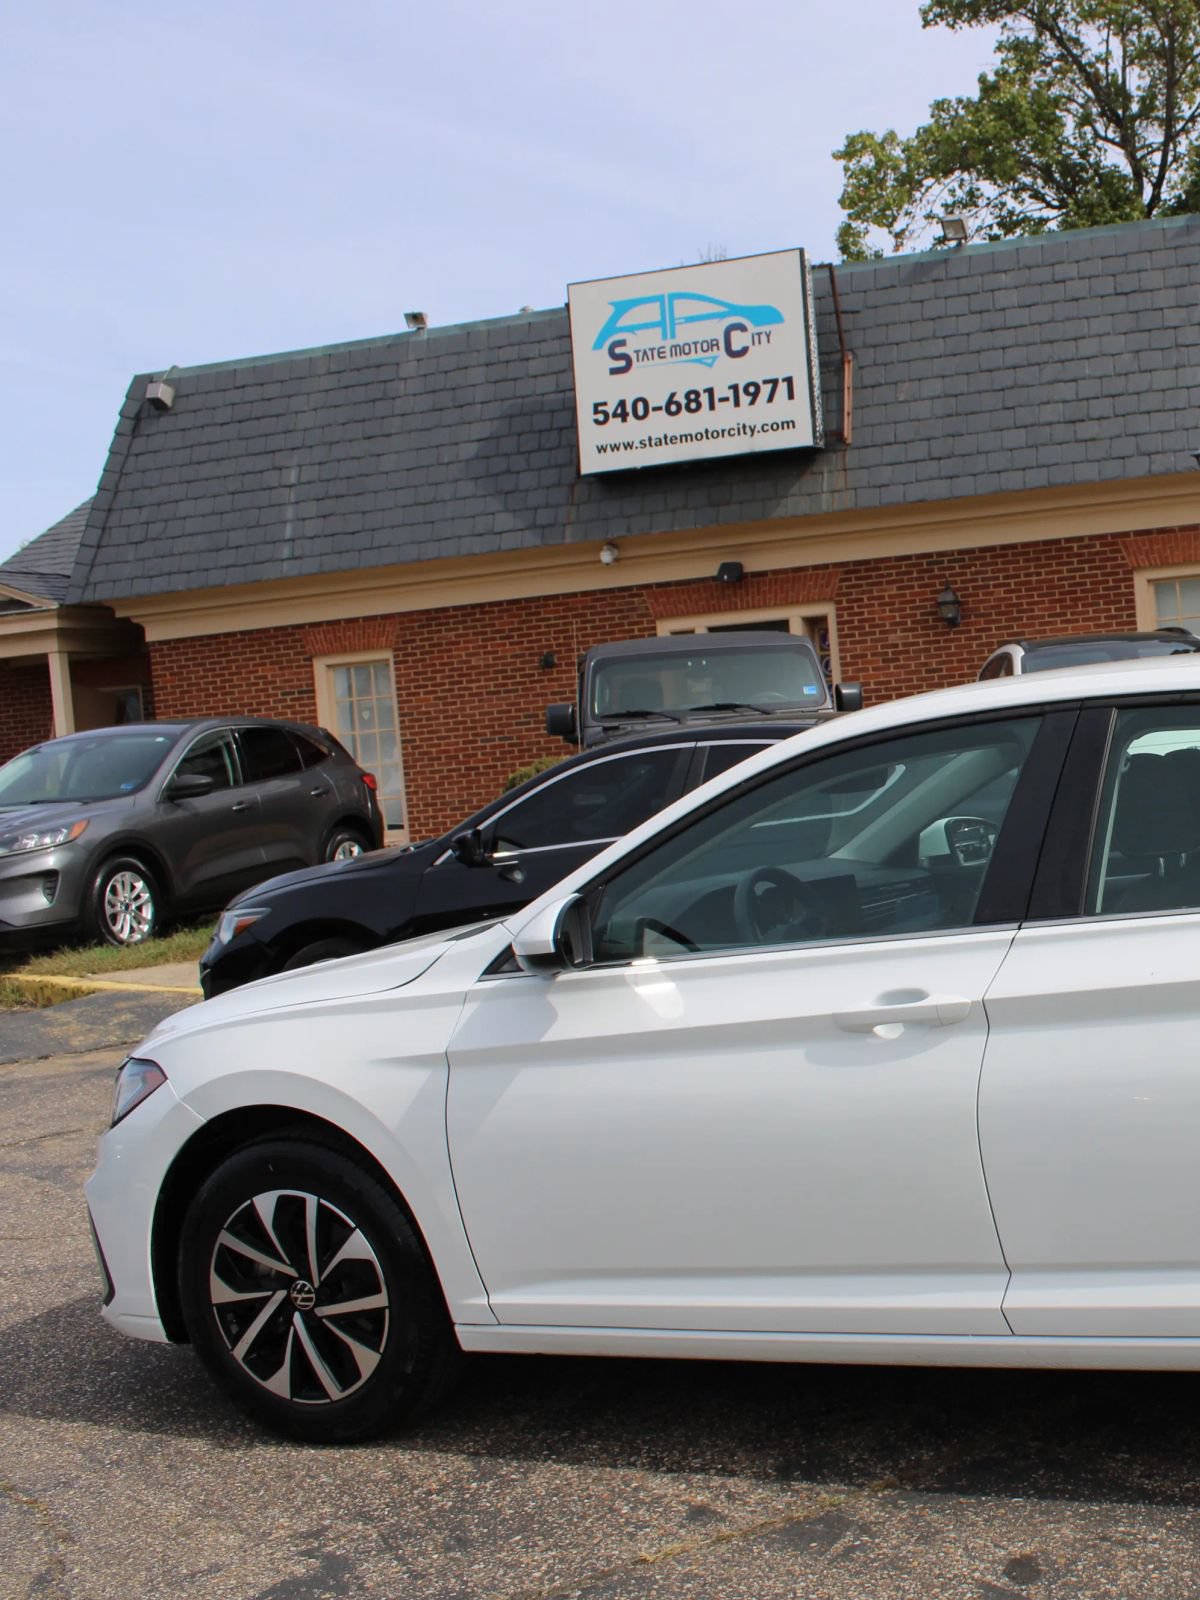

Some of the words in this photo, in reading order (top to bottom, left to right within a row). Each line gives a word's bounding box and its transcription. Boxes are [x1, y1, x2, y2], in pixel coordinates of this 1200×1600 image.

[608, 339, 667, 376] STATE
[669, 338, 720, 358] MOTOR
[723, 322, 772, 359] CITY
[592, 375, 795, 426] 540-681-1971
[596, 418, 796, 455] www.statemotorcity.com
